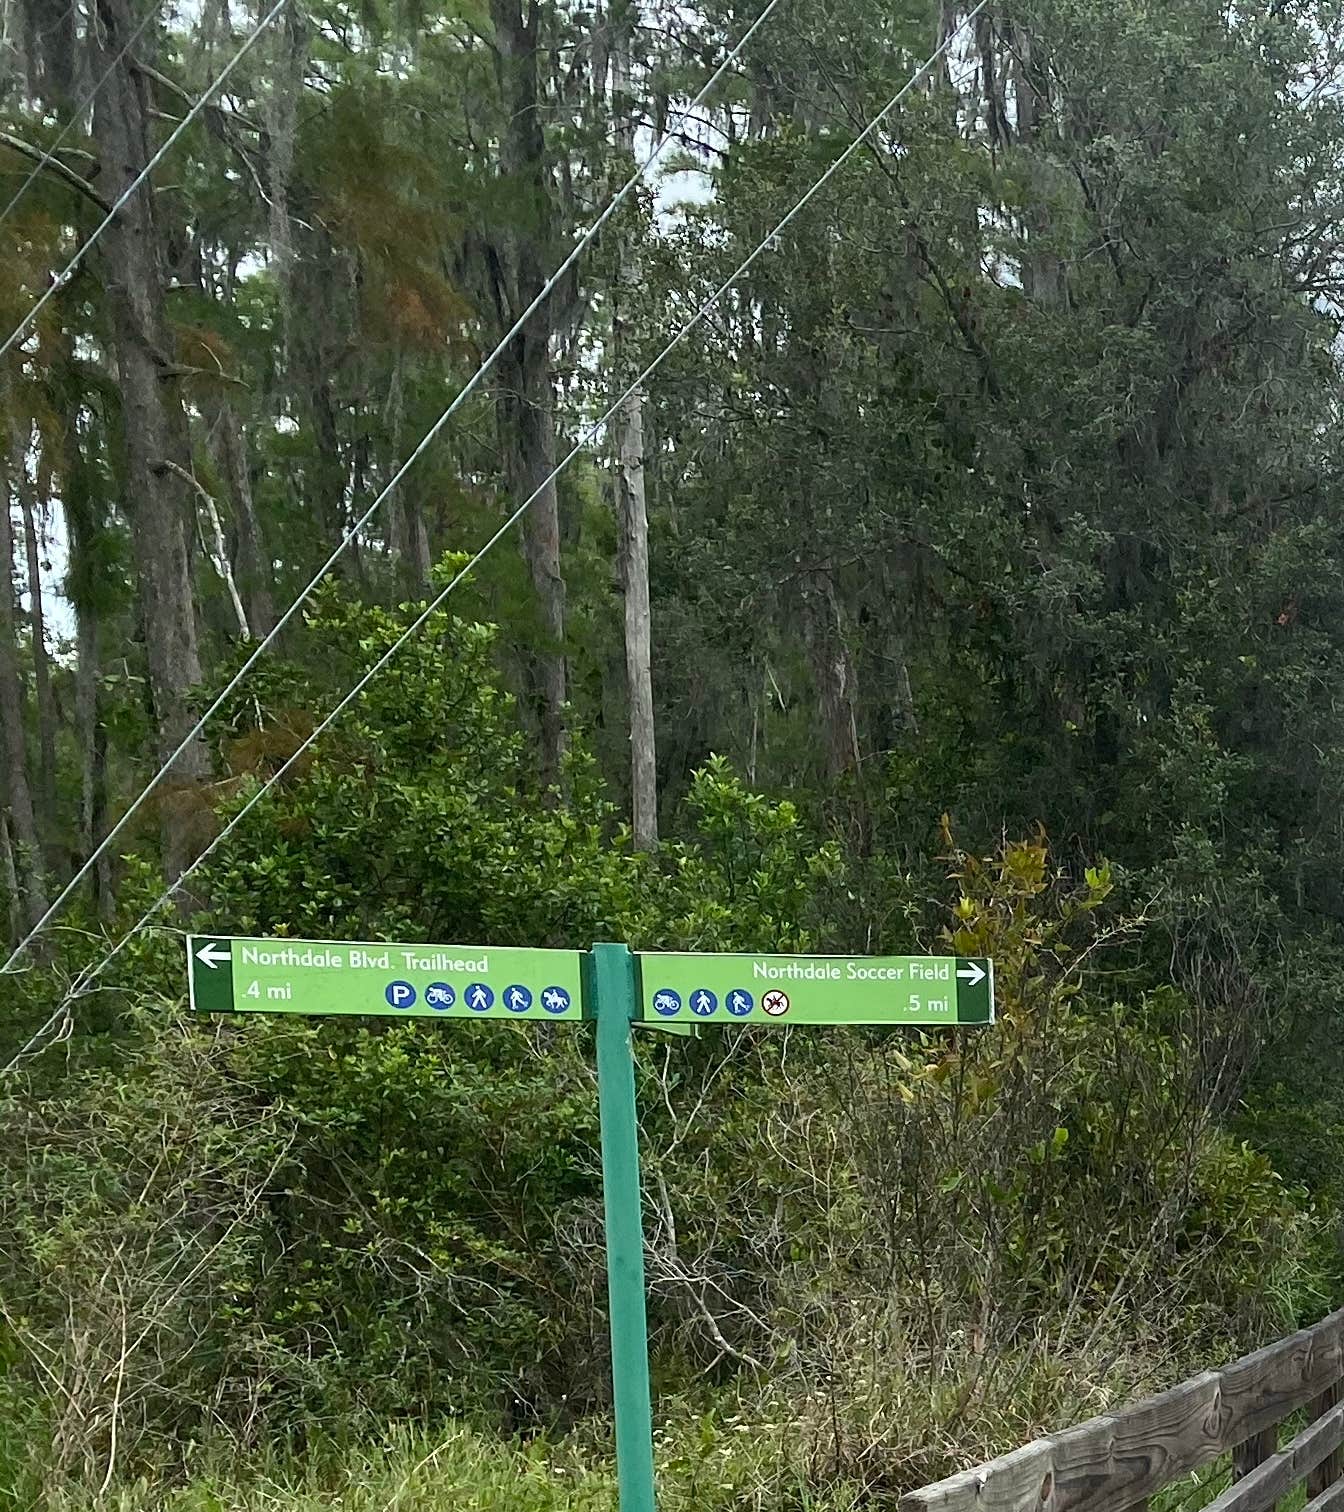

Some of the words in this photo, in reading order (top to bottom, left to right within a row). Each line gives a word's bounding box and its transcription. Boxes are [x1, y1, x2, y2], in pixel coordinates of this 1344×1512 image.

[241, 946, 342, 968] Northdale
[350, 950, 395, 969] Blvd.
[401, 952, 489, 973] Trailhead
[753, 961, 841, 980] Northdale
[847, 962, 904, 980] Soccer
[909, 962, 949, 980] Field
[241, 980, 260, 999] .4
[267, 982, 292, 1000] mi
[903, 994, 921, 1012] .5
[927, 995, 948, 1012] mi
